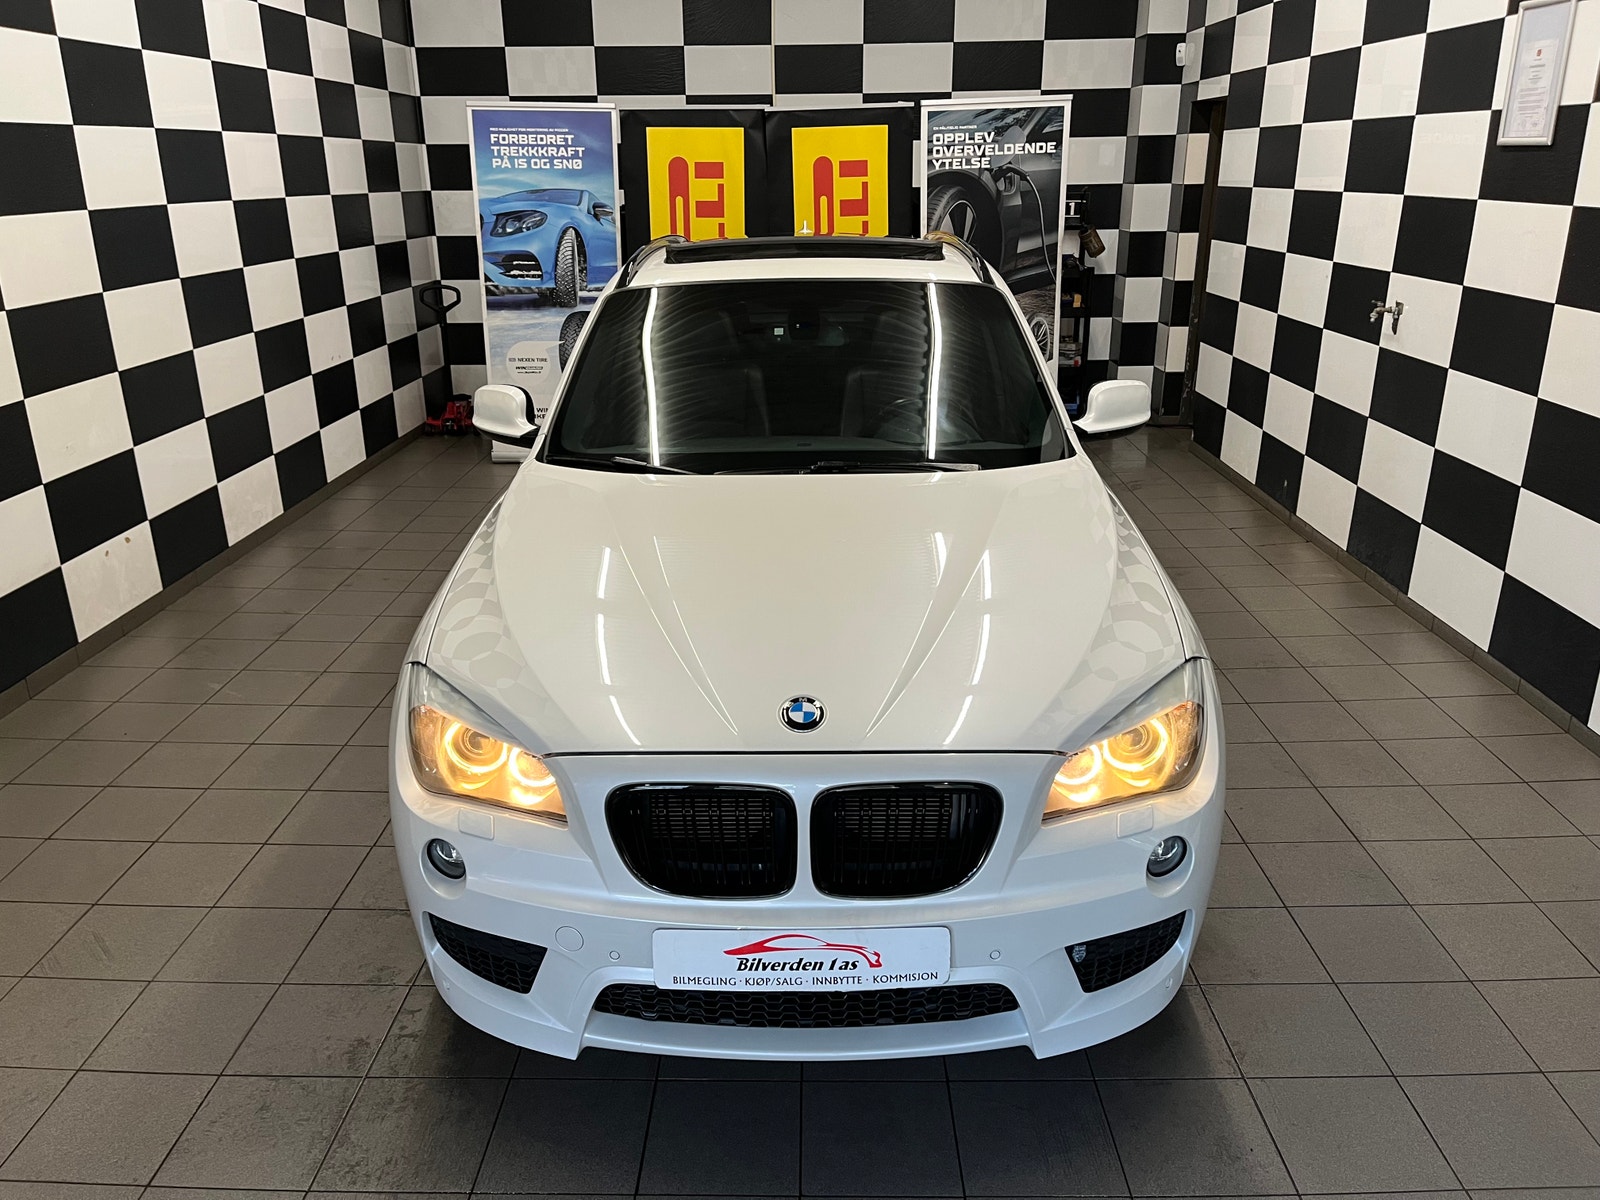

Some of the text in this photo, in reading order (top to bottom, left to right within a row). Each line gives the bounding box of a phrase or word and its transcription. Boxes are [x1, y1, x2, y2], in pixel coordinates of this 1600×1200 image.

[490, 133, 575, 145] FORBEDRET
[933, 132, 995, 145] OPPLEV
[490, 146, 585, 157] TREKKKRAFT
[932, 141, 1057, 158] OVERVELDENDE
[492, 156, 583, 170] PÅ IS OG SNØ
[932, 157, 991, 170] YTELSE
[736, 957, 860, 972] Bilverden 1 as
[673, 972, 938, 986] BILMEGLING KJØP/SALG INNBYTTE KOMMISJON
